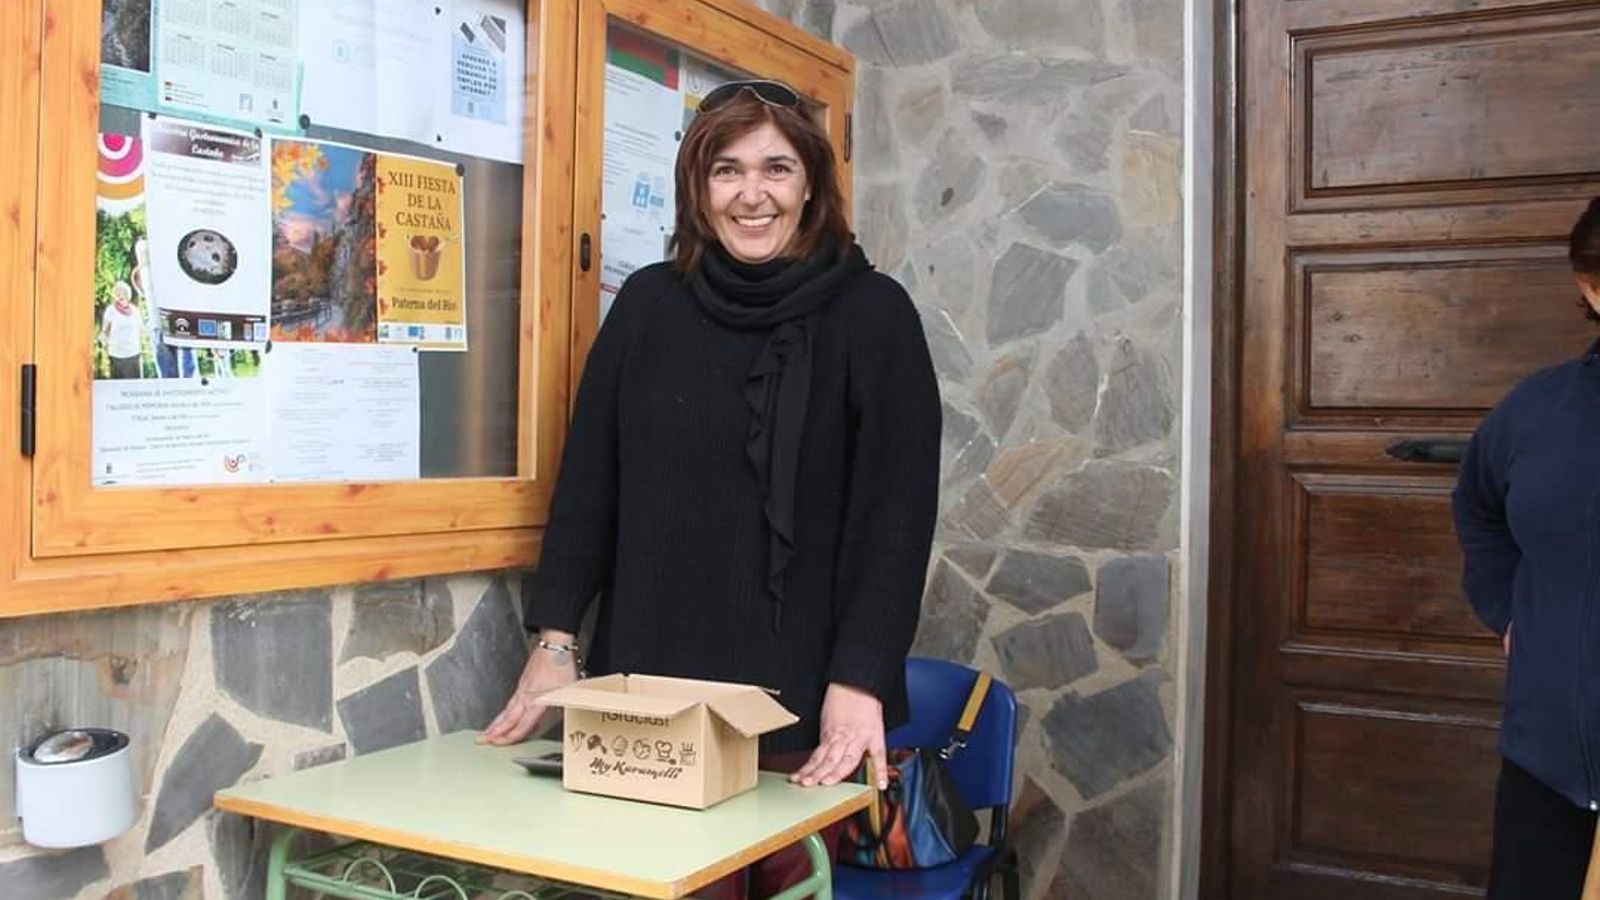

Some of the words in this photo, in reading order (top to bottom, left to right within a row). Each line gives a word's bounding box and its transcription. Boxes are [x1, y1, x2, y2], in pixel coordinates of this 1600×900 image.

[388, 171, 413, 188] XIII
[417, 174, 456, 195] FIESTA
[407, 192, 425, 208] DE
[427, 195, 442, 211] LA
[395, 211, 452, 232] CASTAÑA
[391, 296, 426, 310] Paterna
[427, 298, 442, 311] del
[589, 756, 612, 775] My
